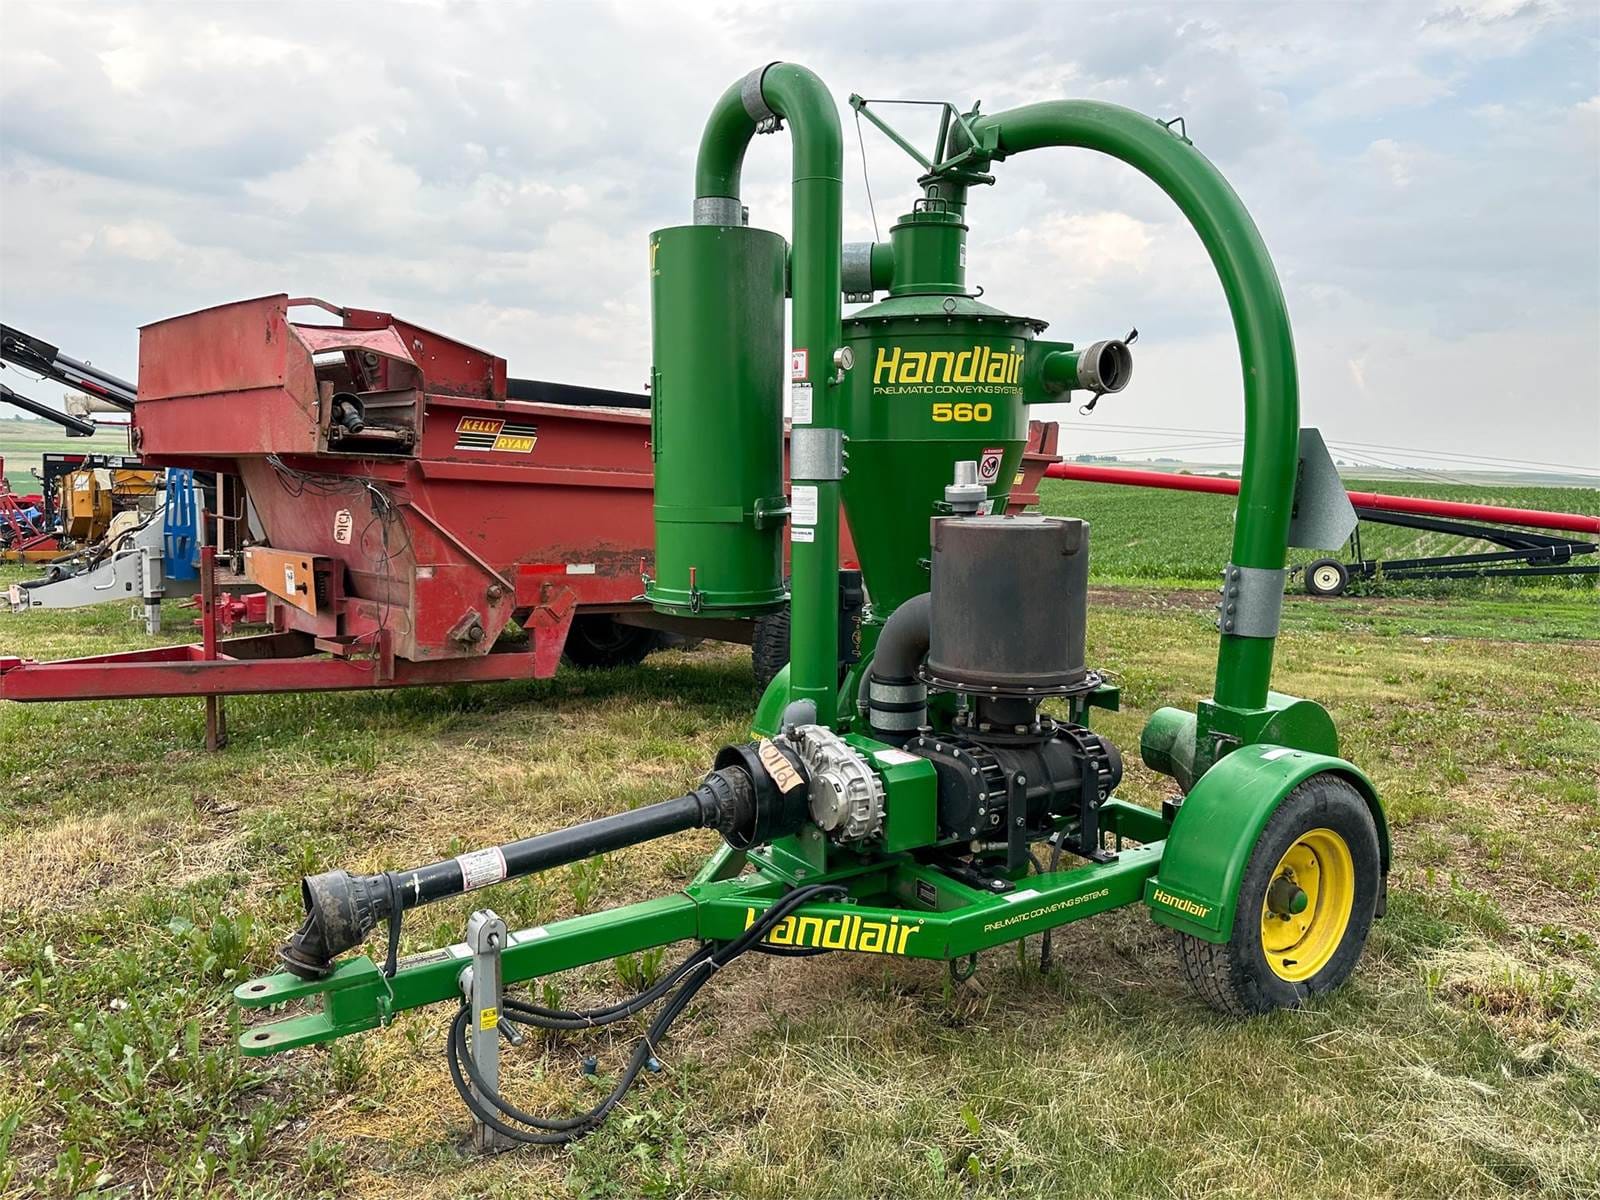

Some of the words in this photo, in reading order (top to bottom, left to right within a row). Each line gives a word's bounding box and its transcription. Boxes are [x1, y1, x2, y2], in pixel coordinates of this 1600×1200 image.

[873, 345, 1024, 384] Handlair
[873, 386, 933, 395] PNEUMATIC
[935, 385, 994, 394] CONVEYING
[994, 386, 1023, 395] SYSTEMS
[932, 403, 992, 422] 560
[463, 419, 499, 432] KELLY
[497, 438, 532, 450] RYAN
[984, 913, 1030, 933] PNEUMATIC
[1030, 898, 1074, 918] CONVEYING
[1074, 888, 1109, 905] SYSTEMS
[1153, 889, 1210, 918] Handlair
